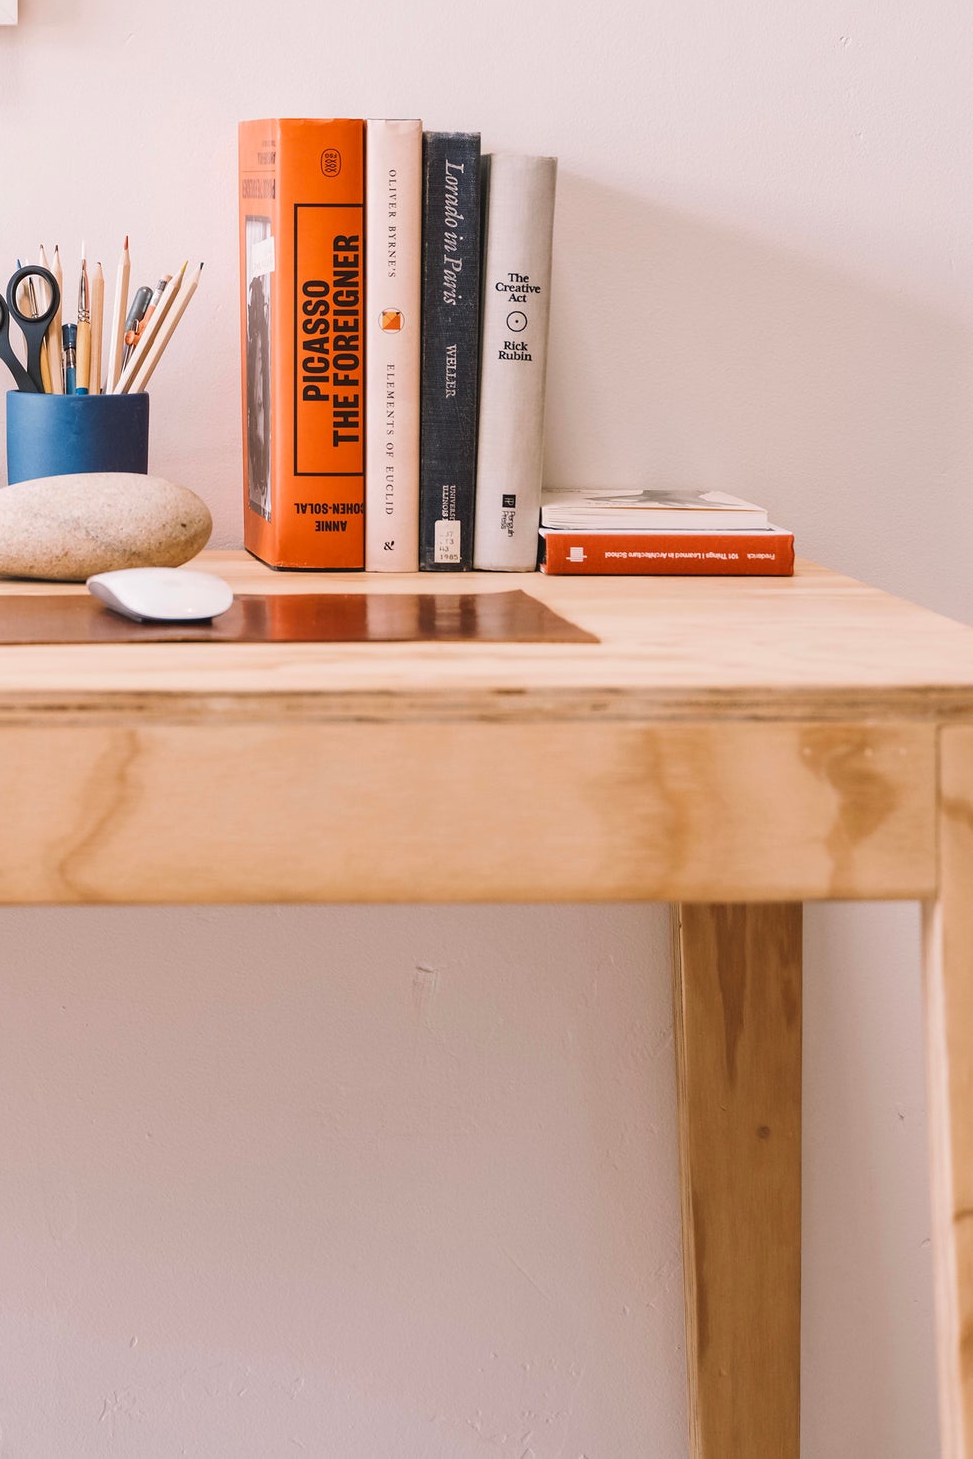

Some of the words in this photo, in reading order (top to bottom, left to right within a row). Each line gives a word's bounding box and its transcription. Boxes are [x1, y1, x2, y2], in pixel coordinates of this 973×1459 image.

[388, 168, 397, 218] OLIVER
[444, 158, 465, 228] Lorado
[387, 226, 397, 278] BYRNE'S
[444, 231, 464, 253] in
[443, 254, 463, 306] Paris
[495, 282, 541, 294] Creative
[508, 273, 530, 283] The
[508, 293, 527, 303] Act
[332, 234, 360, 386] FOREIGNER
[302, 279, 330, 402] PICASSO
[503, 341, 528, 351] Rick
[498, 350, 533, 361] Rubin
[445, 343, 458, 399] WELLER
[386, 364, 396, 436] ELEMENTS
[332, 394, 360, 447] THE
[385, 442, 395, 458] OF
[385, 466, 395, 516] EUCLID
[315, 520, 348, 532] ANNIE
[501, 510, 509, 530] Press
[507, 510, 516, 538] Penguin
[605, 551, 627, 559] School
[628, 551, 667, 559] Architecture
[706, 551, 727, 560] Things
